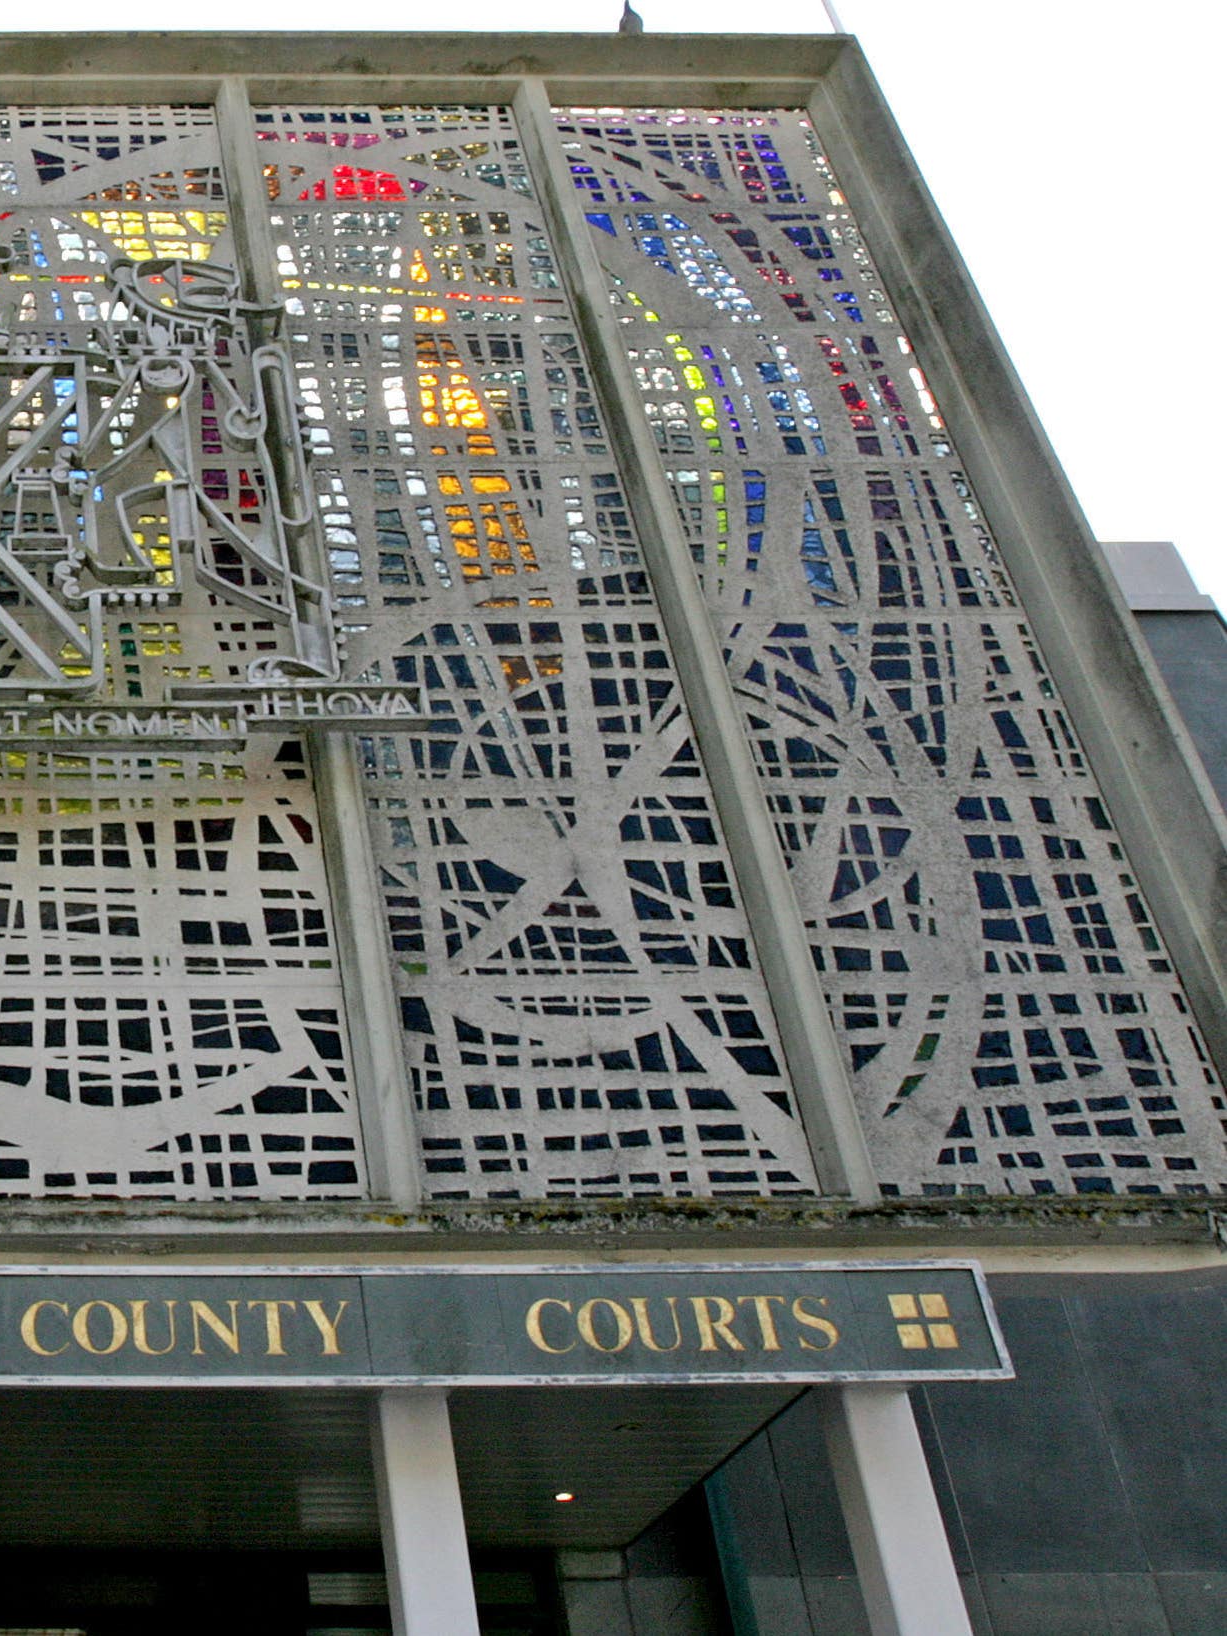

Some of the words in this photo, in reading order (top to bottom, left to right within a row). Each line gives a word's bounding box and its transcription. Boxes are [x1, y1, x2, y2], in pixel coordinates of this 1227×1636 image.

[52, 710, 221, 736] NOMEN
[20, 1299, 347, 1356] COUNTY
[525, 1294, 840, 1353] COURTS
